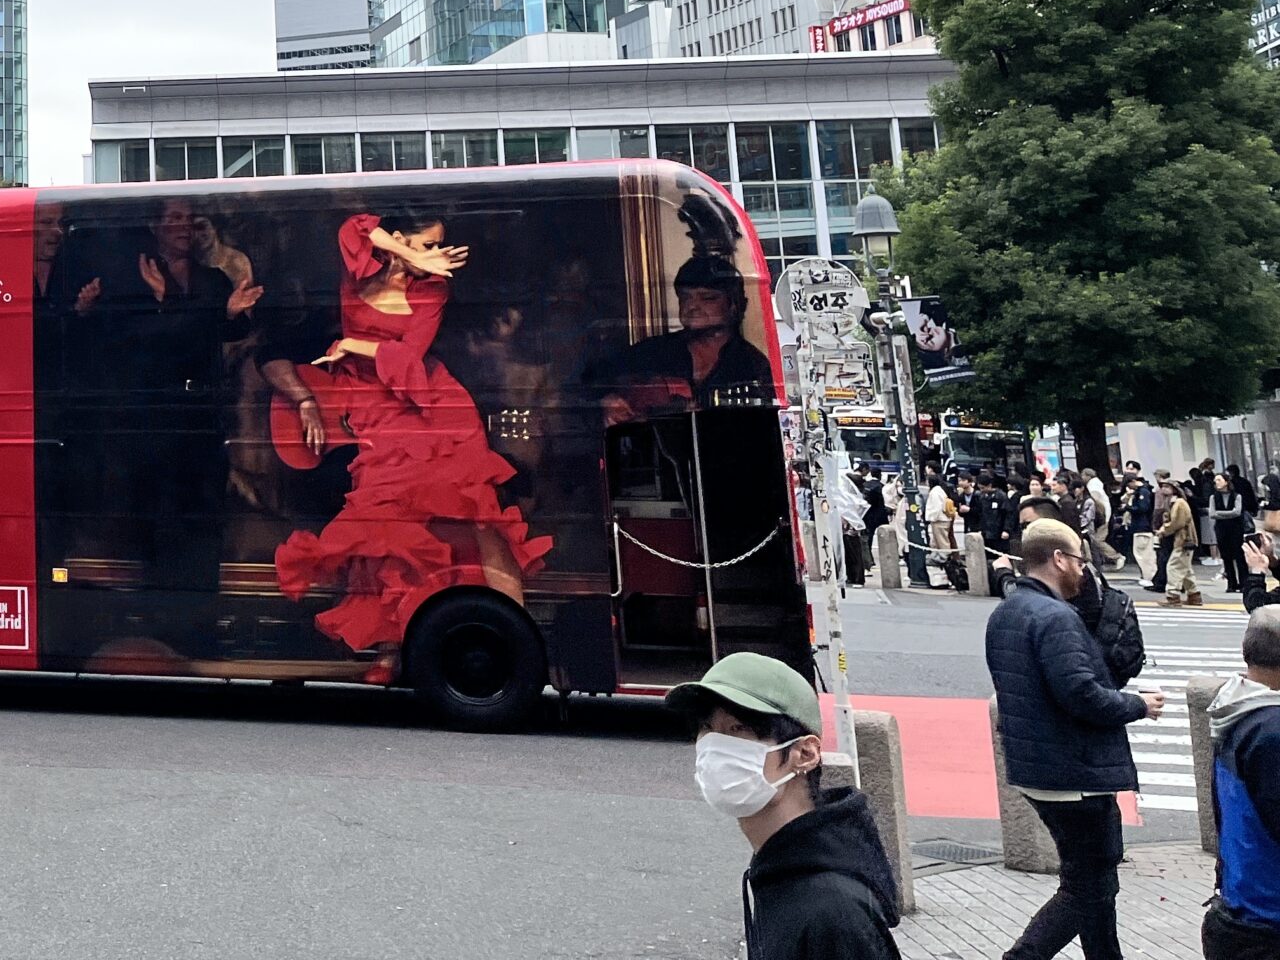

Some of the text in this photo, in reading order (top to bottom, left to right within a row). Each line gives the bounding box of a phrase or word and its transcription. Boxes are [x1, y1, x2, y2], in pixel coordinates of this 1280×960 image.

[834, 13, 865, 33] カラオケ
[0, 602, 8, 613] IN
